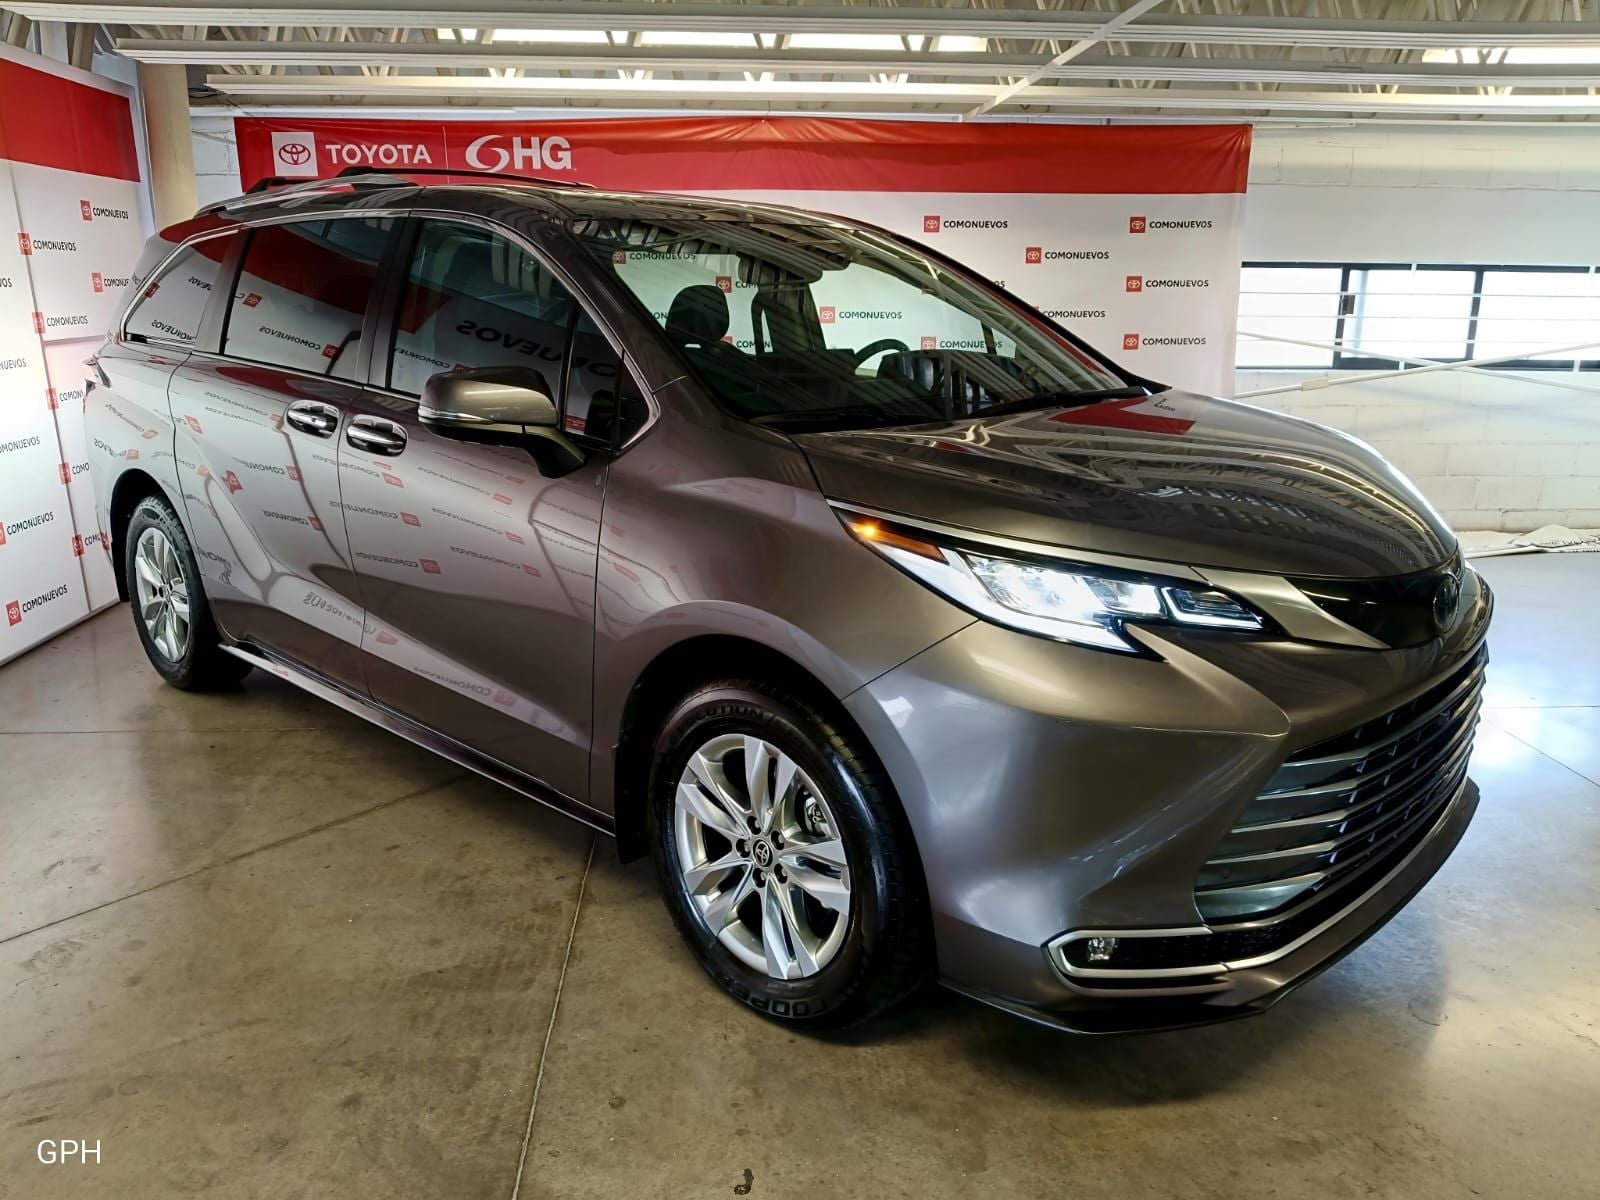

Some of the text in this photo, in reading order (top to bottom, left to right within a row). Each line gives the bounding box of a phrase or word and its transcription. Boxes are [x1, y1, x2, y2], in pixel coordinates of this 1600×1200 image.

[326, 144, 432, 164] TOYOTA
[92, 207, 129, 219] COMONUEVOS
[943, 220, 1008, 229] COMONUEVOS
[1149, 220, 1212, 229] COMONUEVOS
[33, 240, 77, 251] COMONUEVOS
[1044, 251, 1110, 260] COMONUEVOS
[1145, 279, 1209, 288] COMONUEVOS
[47, 315, 88, 326] COMONUEVOS
[839, 311, 902, 320] COMONUEVOS
[1142, 336, 1206, 346] COMONUEVOS
[0, 358, 27, 370] NUEVOS
[59, 390, 83, 402] COMON
[7, 511, 54, 536] COMONUEVOS
[22, 584, 68, 613] COMONUEVOS
